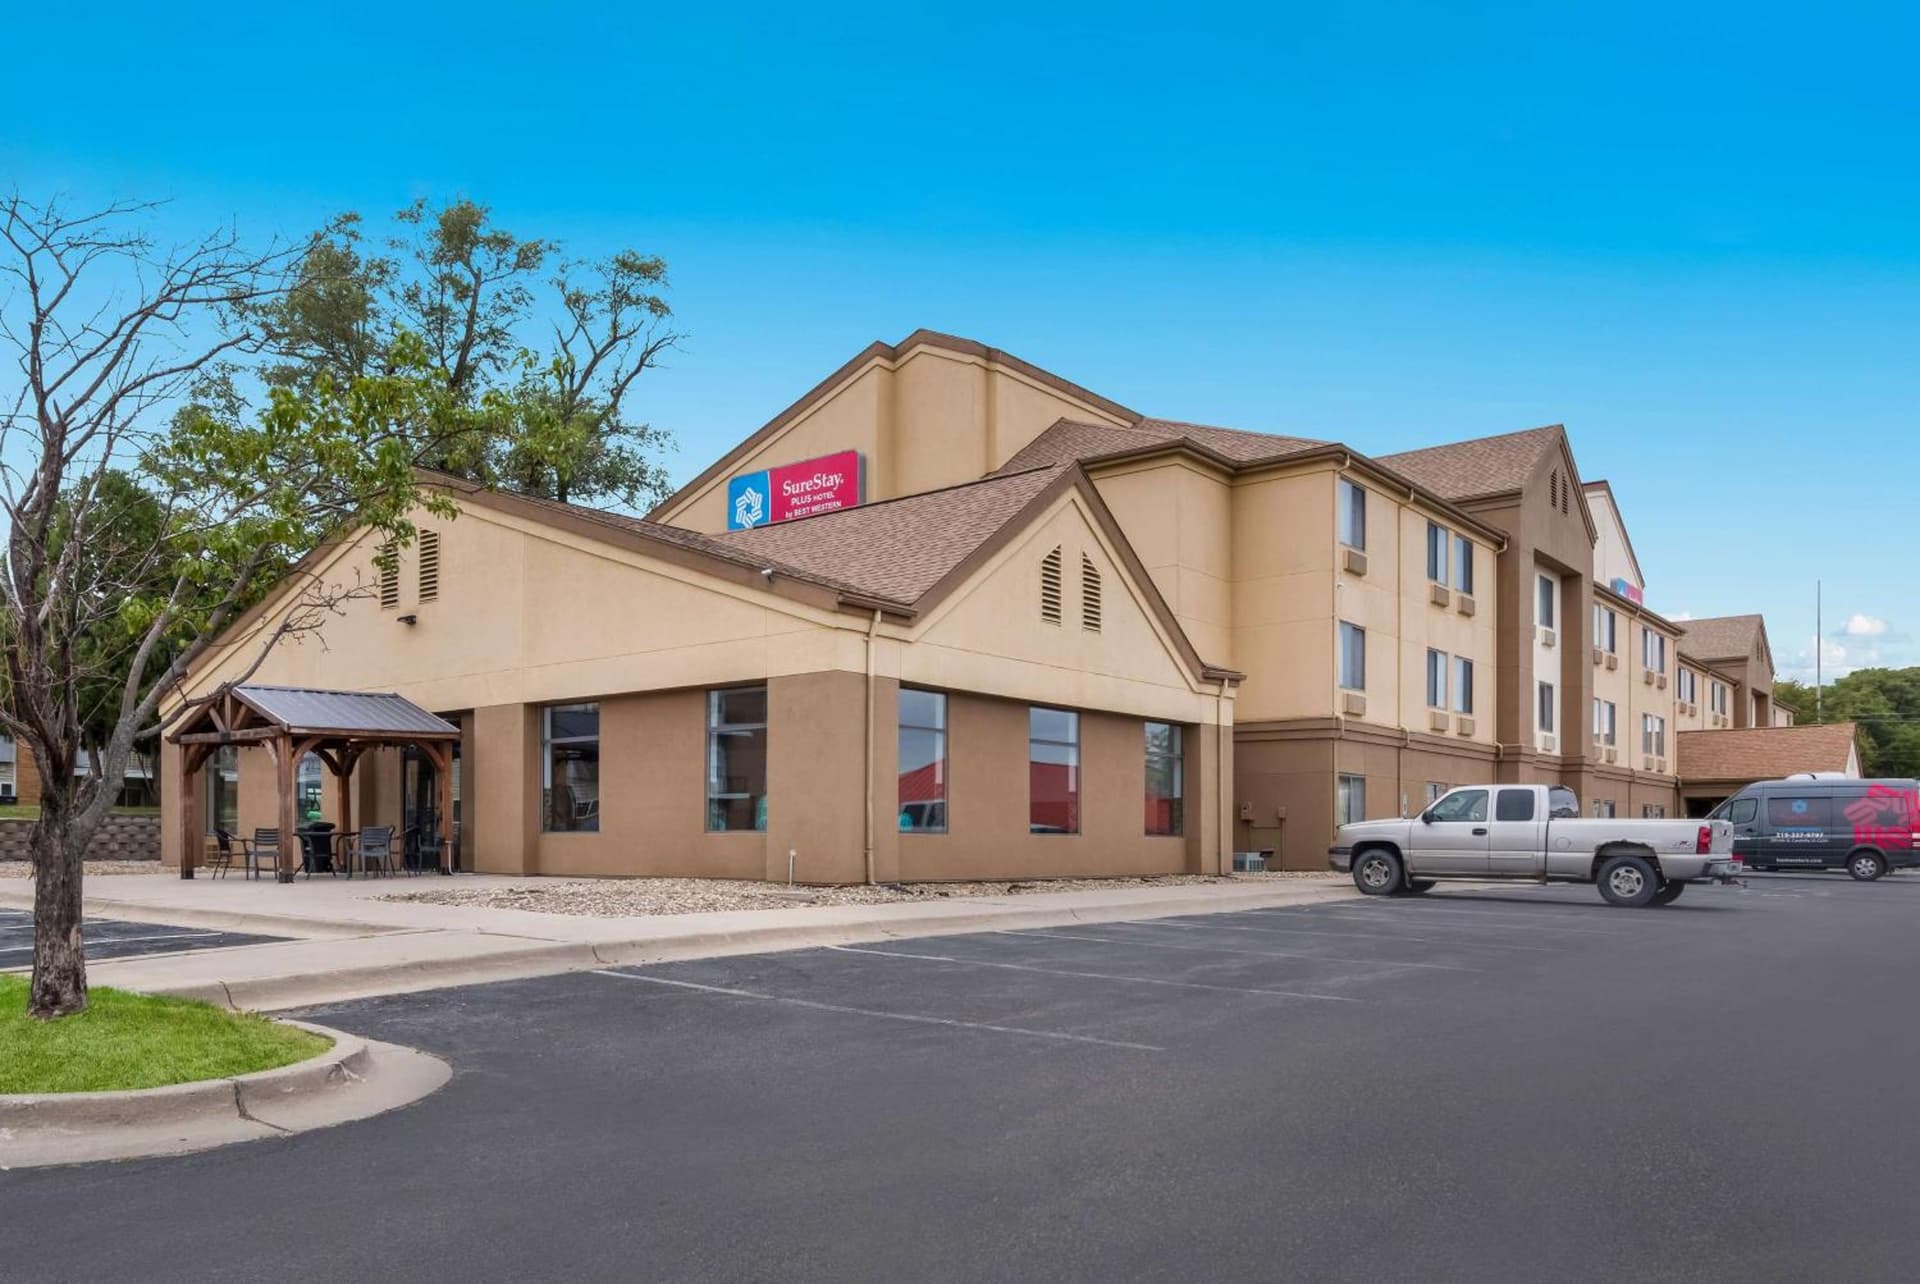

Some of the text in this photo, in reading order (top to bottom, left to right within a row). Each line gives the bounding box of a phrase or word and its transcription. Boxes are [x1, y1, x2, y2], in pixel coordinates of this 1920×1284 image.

[791, 492, 834, 505] PLUS HOTEL
[794, 506, 811, 517] BEST
[811, 501, 842, 512] WESTERN
